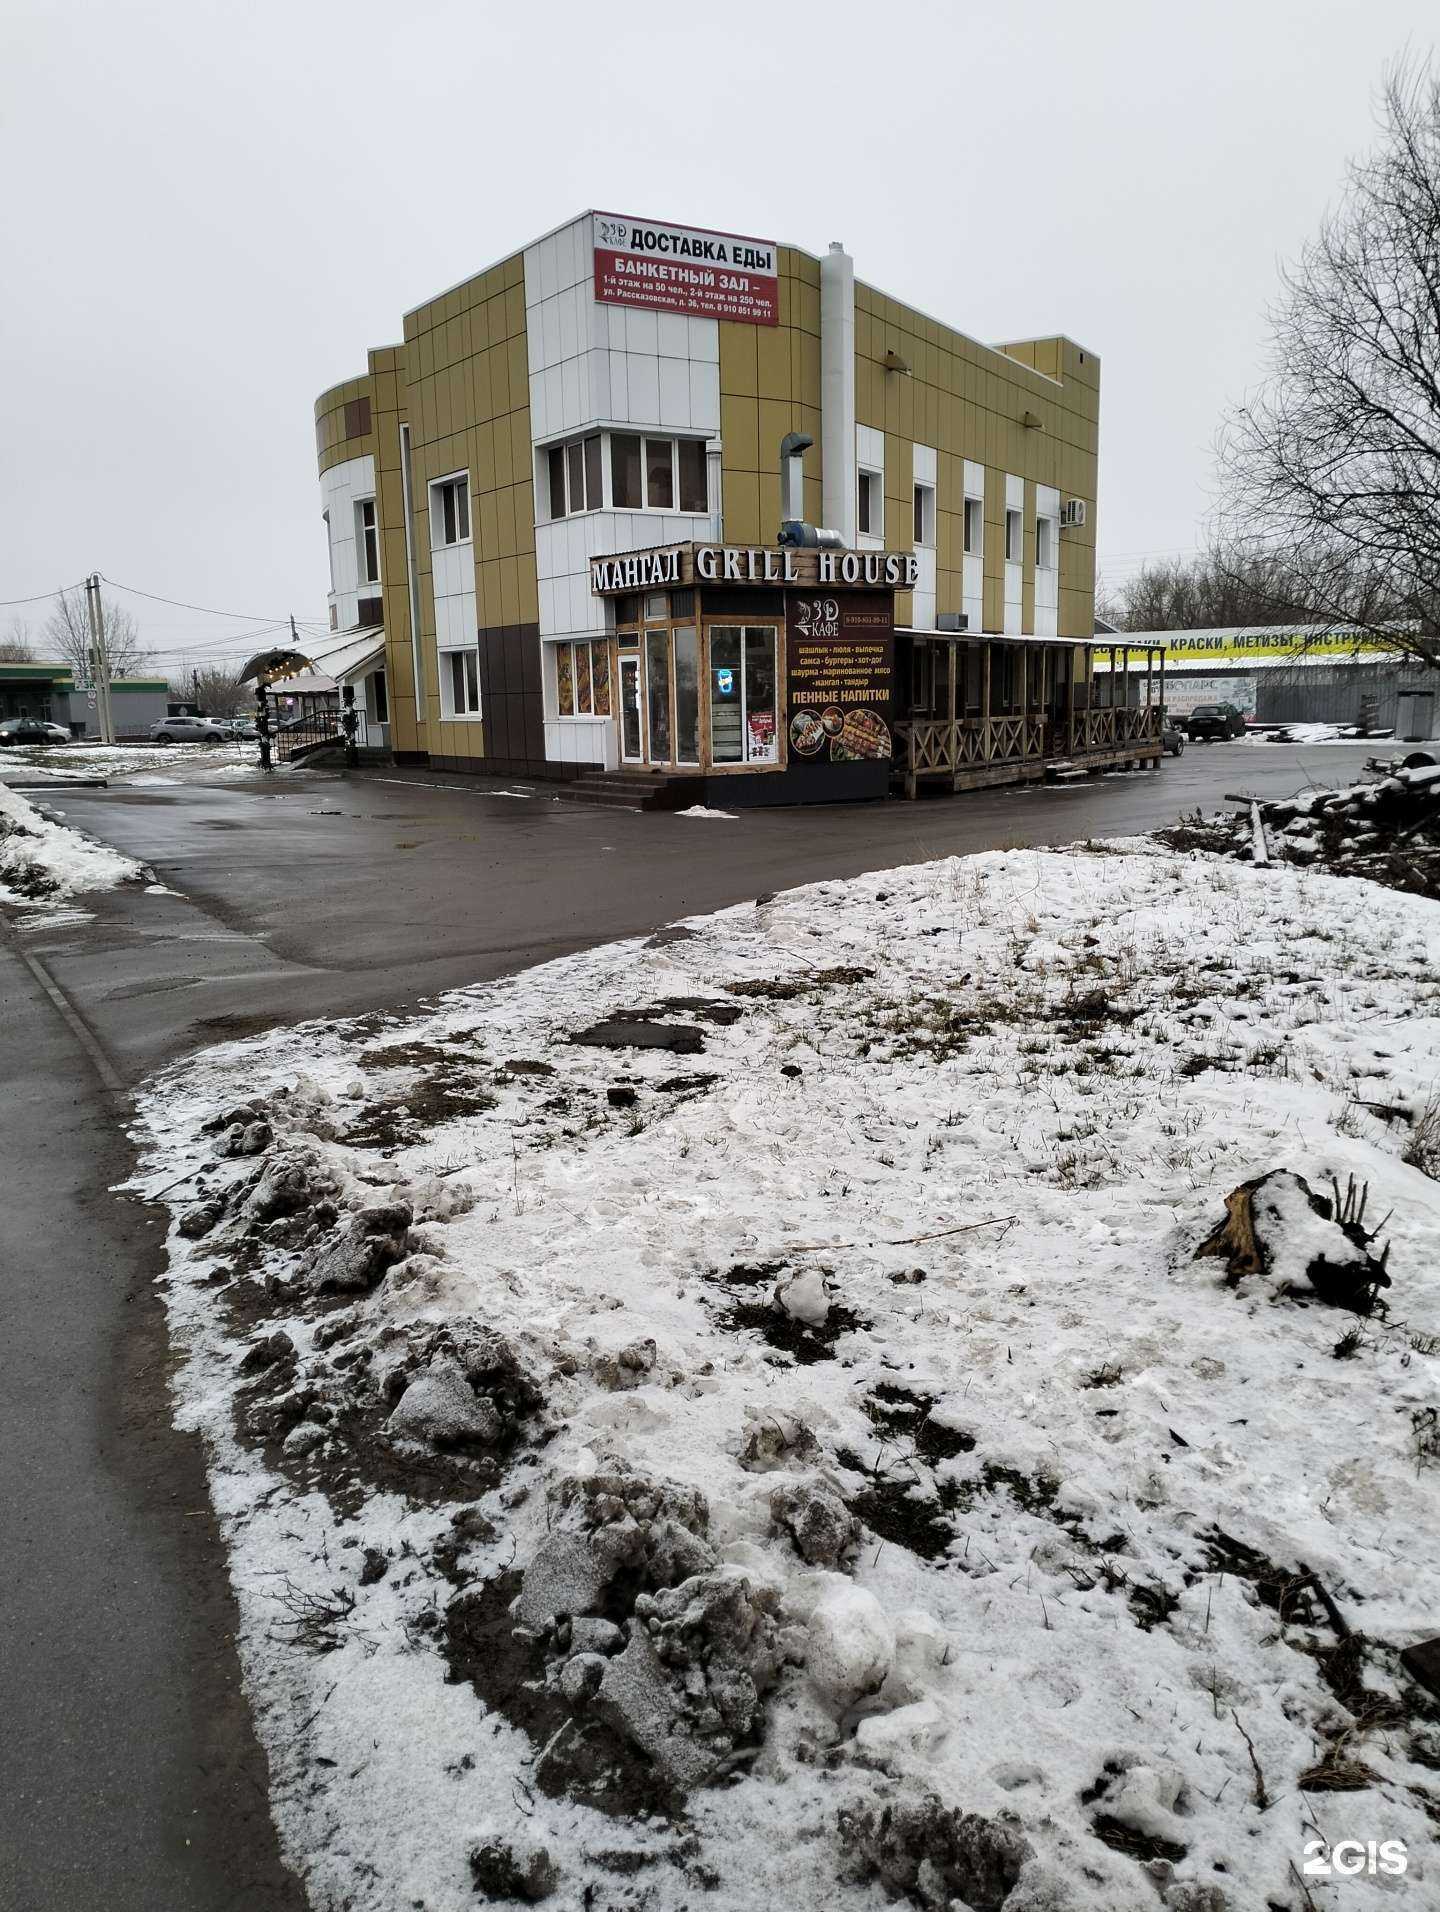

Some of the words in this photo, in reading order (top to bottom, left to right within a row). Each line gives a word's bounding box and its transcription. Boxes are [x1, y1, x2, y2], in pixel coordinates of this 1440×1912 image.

[630, 228, 727, 262] ДОСТАВКА
[732, 246, 771, 270] ЕДЫ
[614, 257, 715, 286] БАНКЕТНЫЙ
[719, 274, 749, 292] ЗАЛ
[603, 274, 617, 285] 1-й
[618, 278, 641, 288] этаж
[642, 282, 654, 291] на
[655, 282, 667, 292] 50
[689, 288, 703, 298] 2-й
[704, 291, 726, 302] этаж
[727, 295, 738, 303] на
[739, 295, 754, 305] 250
[755, 298, 773, 308] чел.
[603, 287, 615, 297] ул.
[701, 302, 716, 311] тел.
[717, 303, 723, 312] 8
[763, 310, 772, 319] 11
[591, 550, 680, 593] МАНГАЛ
[697, 547, 800, 582] GRILL
[818, 552, 918, 585] HOUSE
[812, 622, 839, 636] КАФЕ
[832, 646, 851, 654] люля
[855, 646, 884, 654] выпечка
[1170, 636, 1228, 652] КРАСКИ,
[1233, 633, 1299, 649] МЕТИЗЫ,
[800, 657, 821, 665] самса
[824, 655, 854, 667] бургеры
[791, 669, 819, 678] шаурма
[822, 667, 873, 678] маринованное
[874, 667, 891, 675] мясо
[815, 679, 840, 687] мангал
[844, 678, 869, 688] тандыр
[792, 691, 839, 704] ПЕННЫЕ
[841, 688, 890, 702] НАПИТКИ
